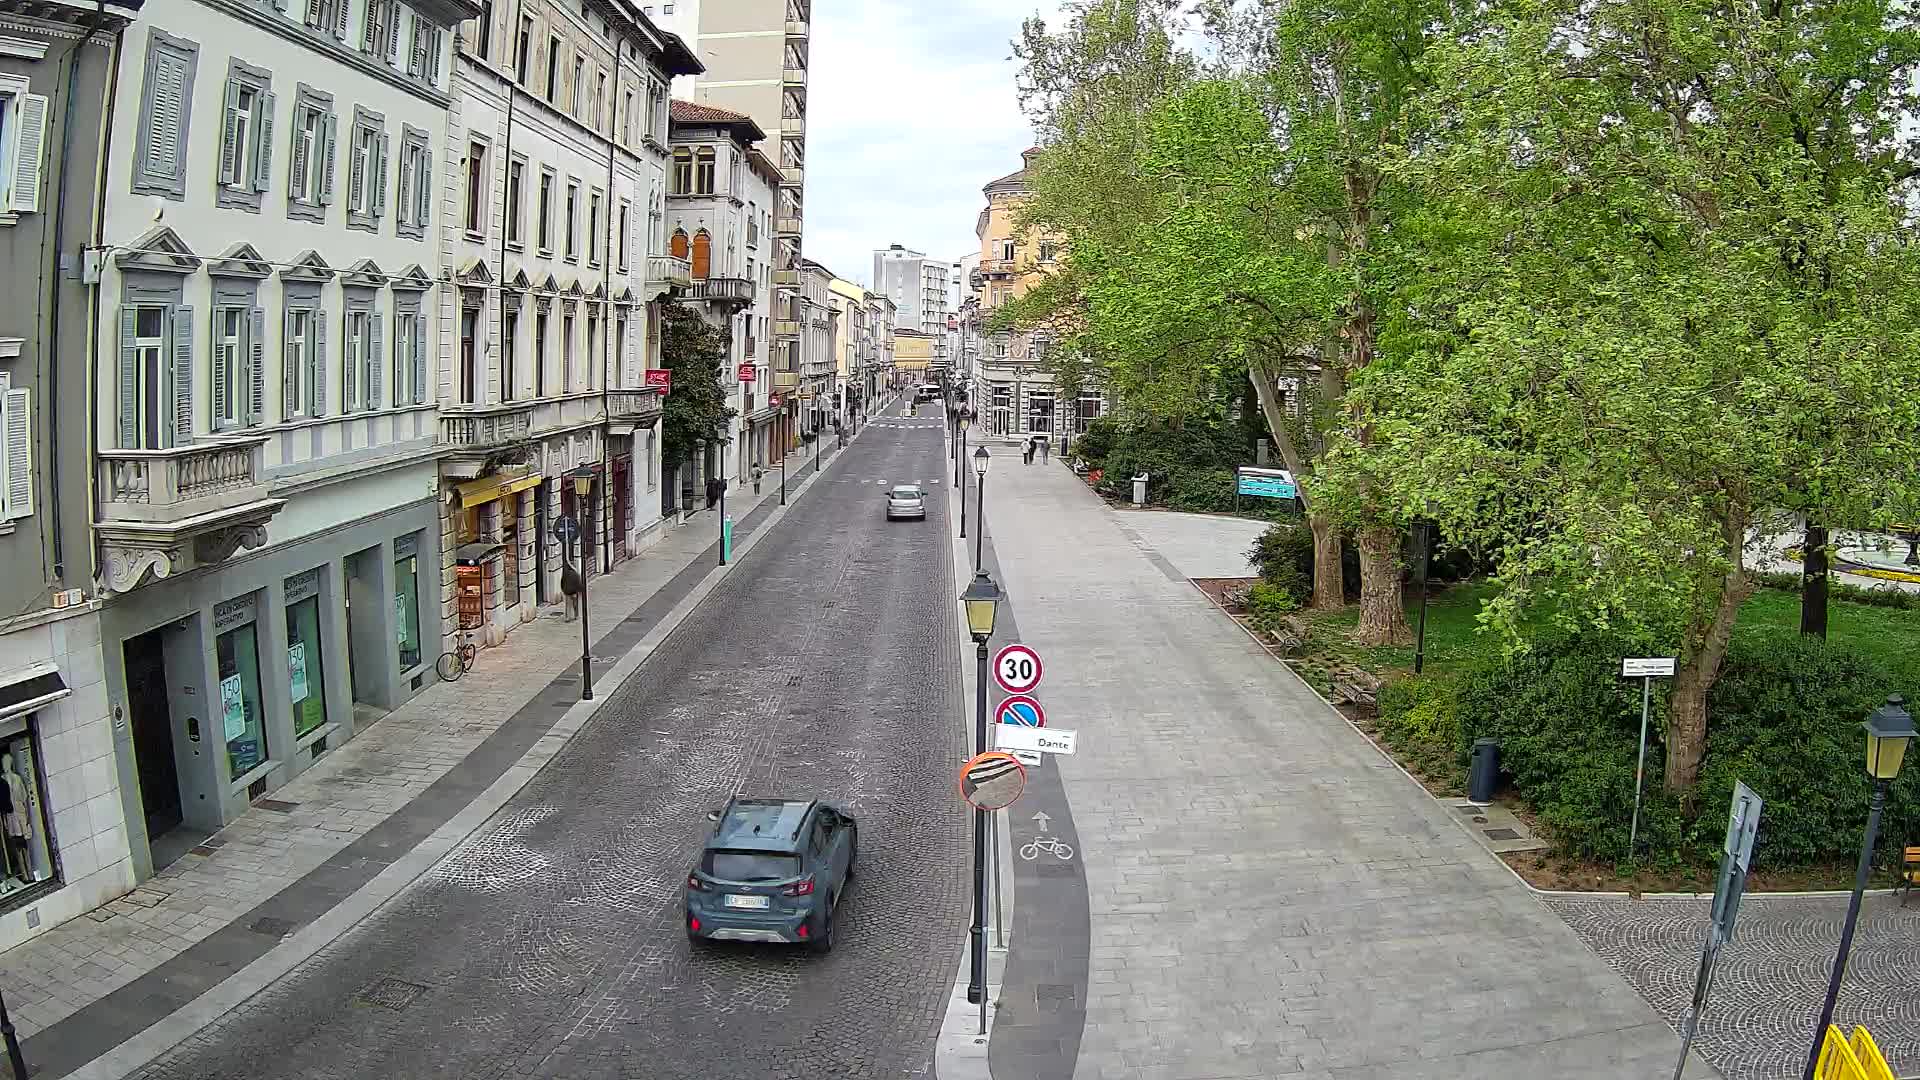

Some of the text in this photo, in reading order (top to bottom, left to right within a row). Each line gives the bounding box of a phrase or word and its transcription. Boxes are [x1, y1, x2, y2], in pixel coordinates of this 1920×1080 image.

[1005, 658, 1032, 680] 30
[221, 678, 240, 697] 130
[1038, 738, 1069, 750] Dante
